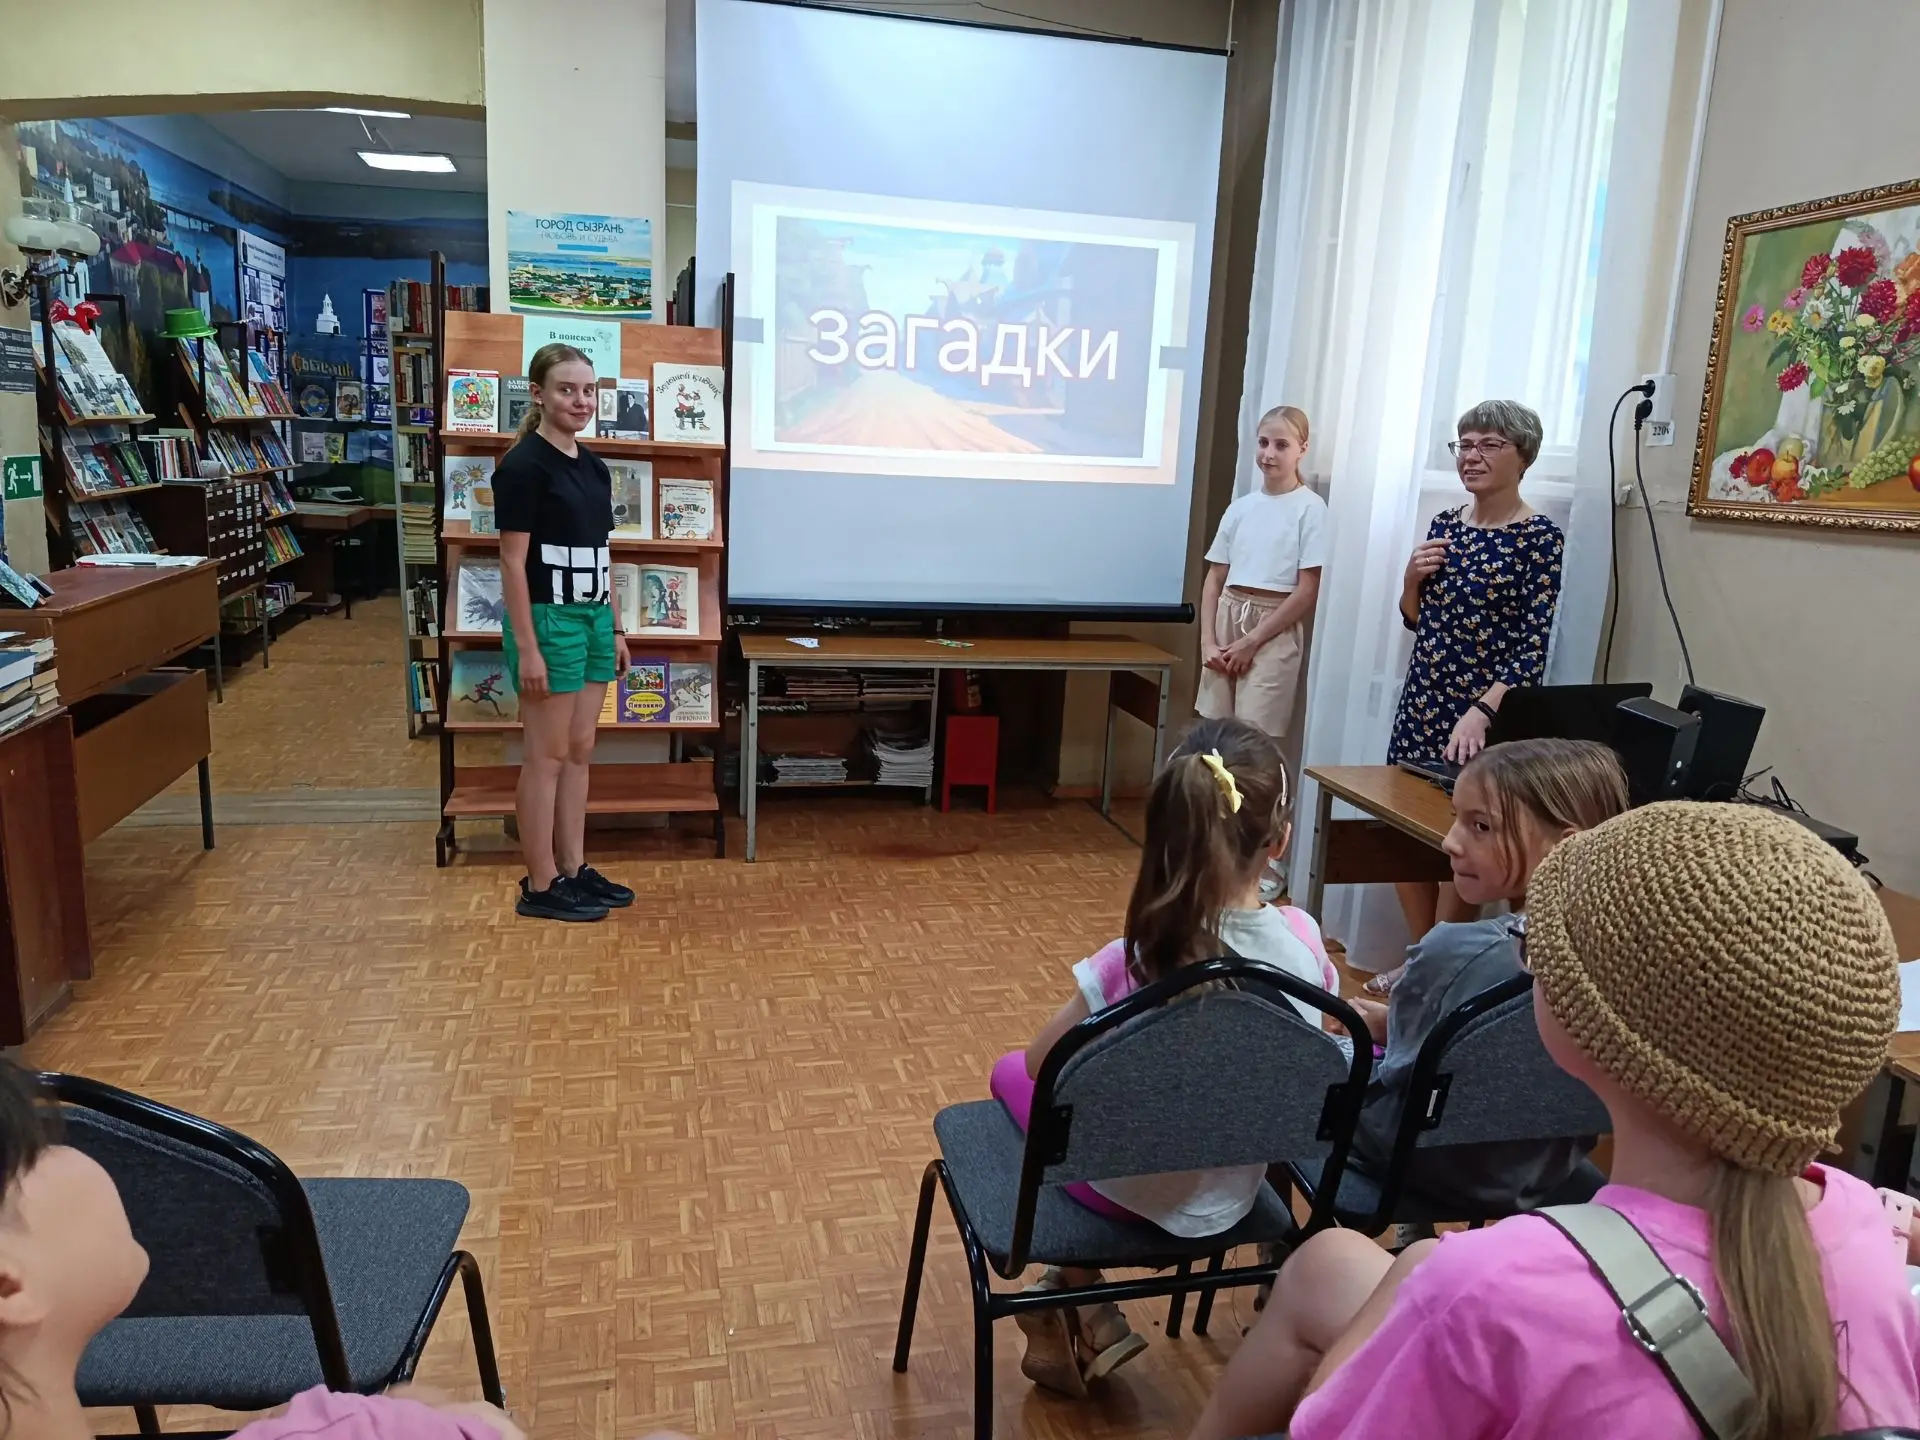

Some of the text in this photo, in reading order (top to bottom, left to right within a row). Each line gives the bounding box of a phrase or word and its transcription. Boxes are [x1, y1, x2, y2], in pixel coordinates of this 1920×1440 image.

[535, 218, 625, 234] ГОРОД СЫЗРАНЬ
[549, 331, 596, 342] В поисках
[807, 308, 1120, 388] загадки
